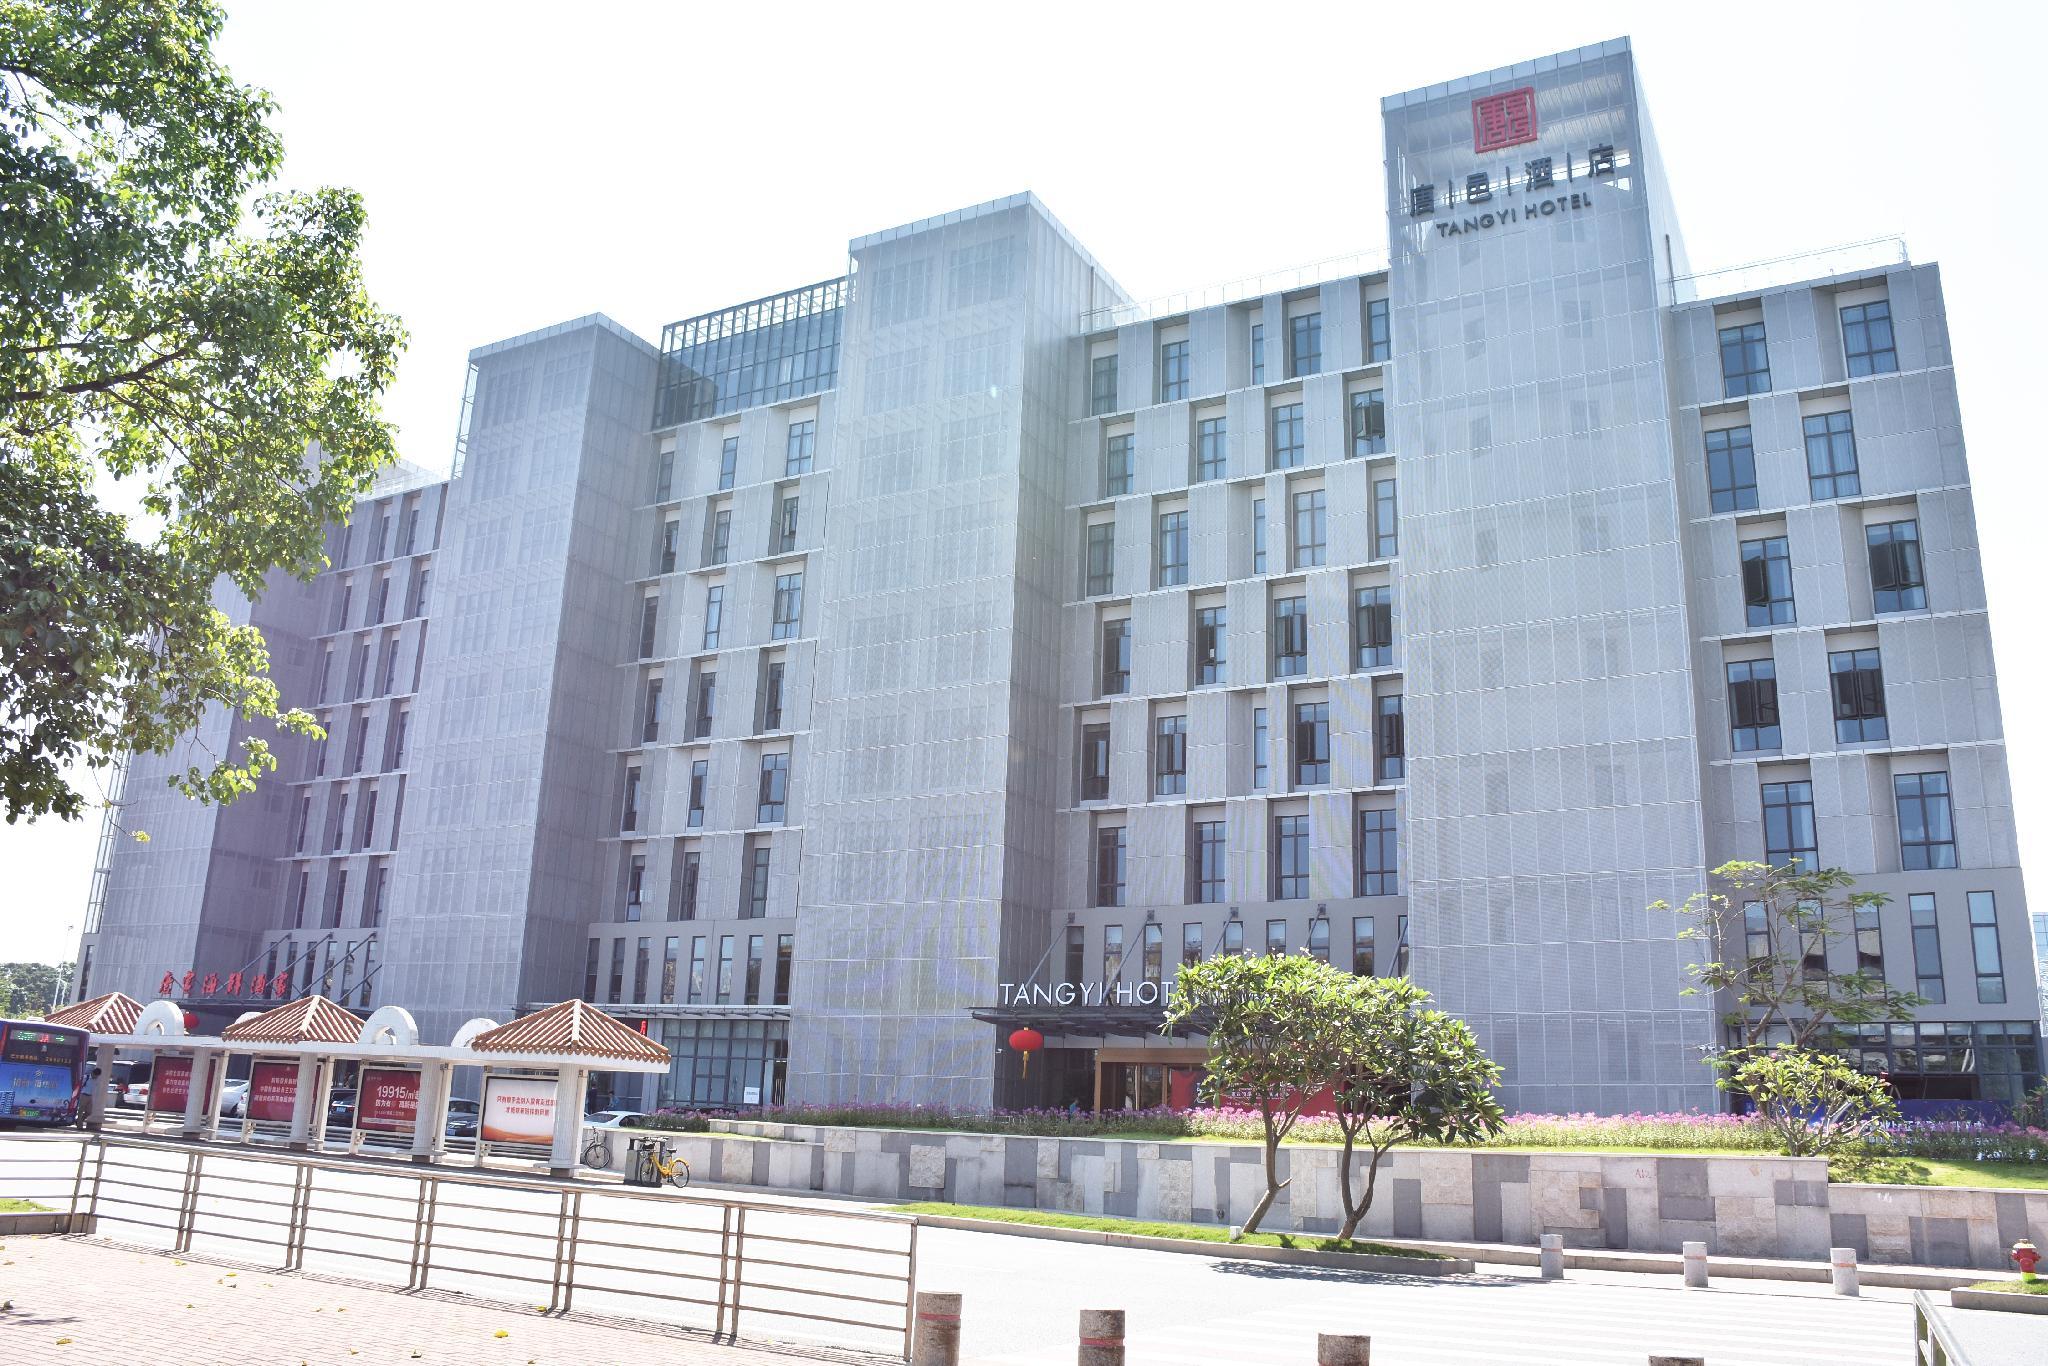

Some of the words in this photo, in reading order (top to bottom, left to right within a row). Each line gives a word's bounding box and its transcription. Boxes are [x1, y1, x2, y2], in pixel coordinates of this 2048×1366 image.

[1436, 208, 1516, 238] TANGYI
[1525, 192, 1592, 220] HOTEL
[1000, 982, 1103, 1006] TANGYI
